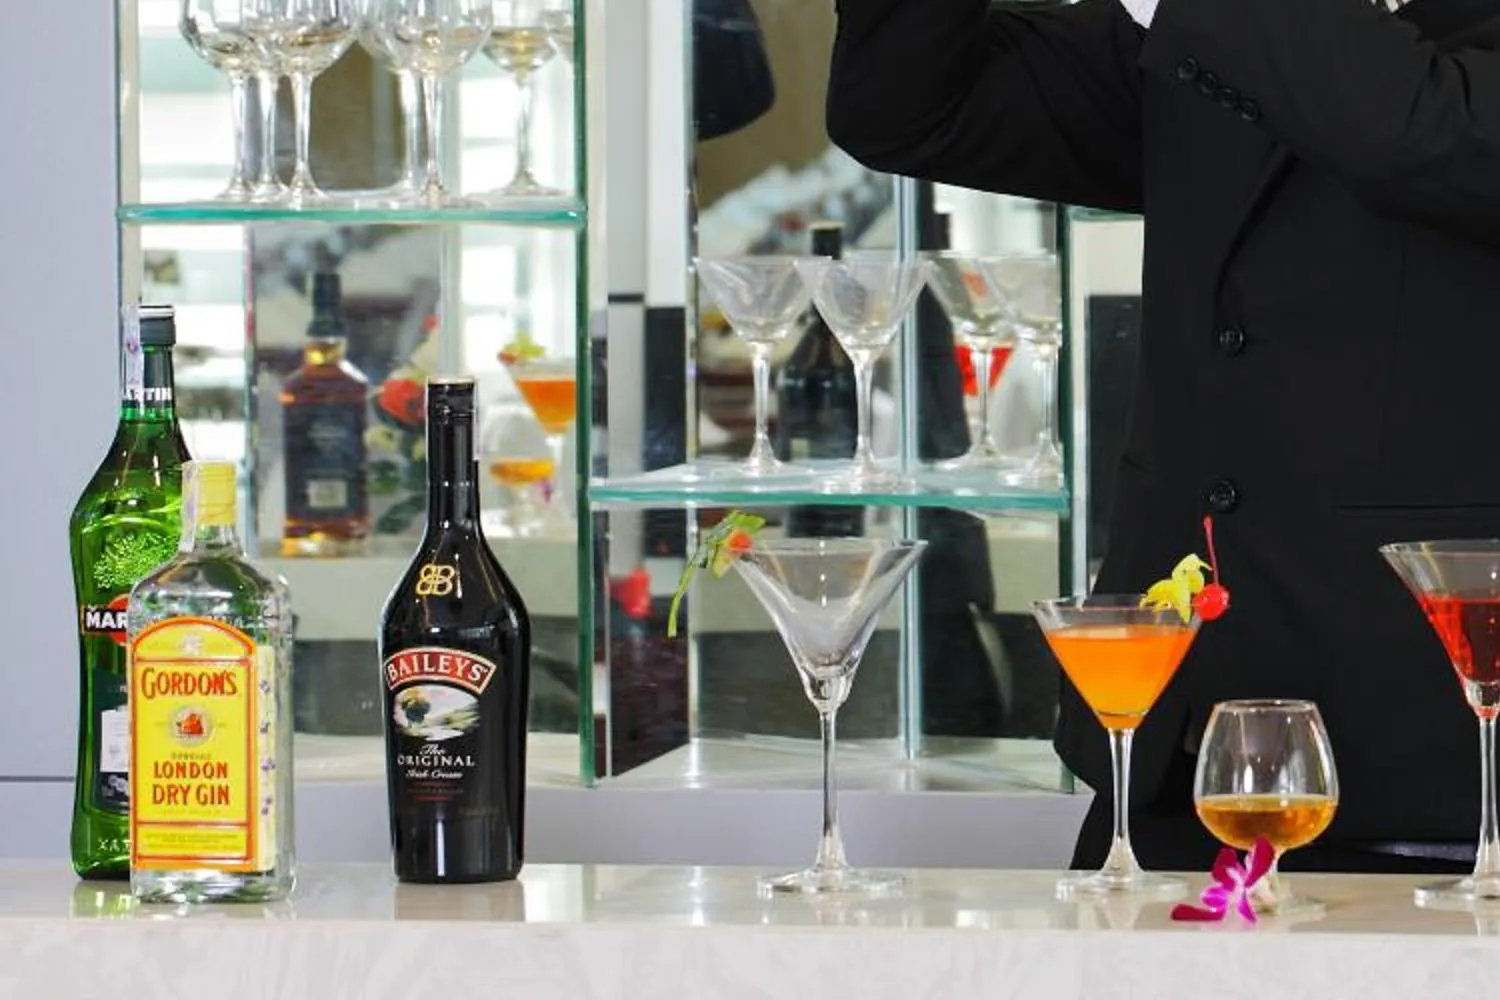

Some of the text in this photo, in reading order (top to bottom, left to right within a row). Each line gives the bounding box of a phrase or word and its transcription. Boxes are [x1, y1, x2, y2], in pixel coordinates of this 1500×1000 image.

[386, 653, 487, 682] BAILEYS
[153, 760, 229, 779] LONDON
[397, 754, 476, 767] ORIGINAL
[152, 783, 230, 806] DRY GIN
